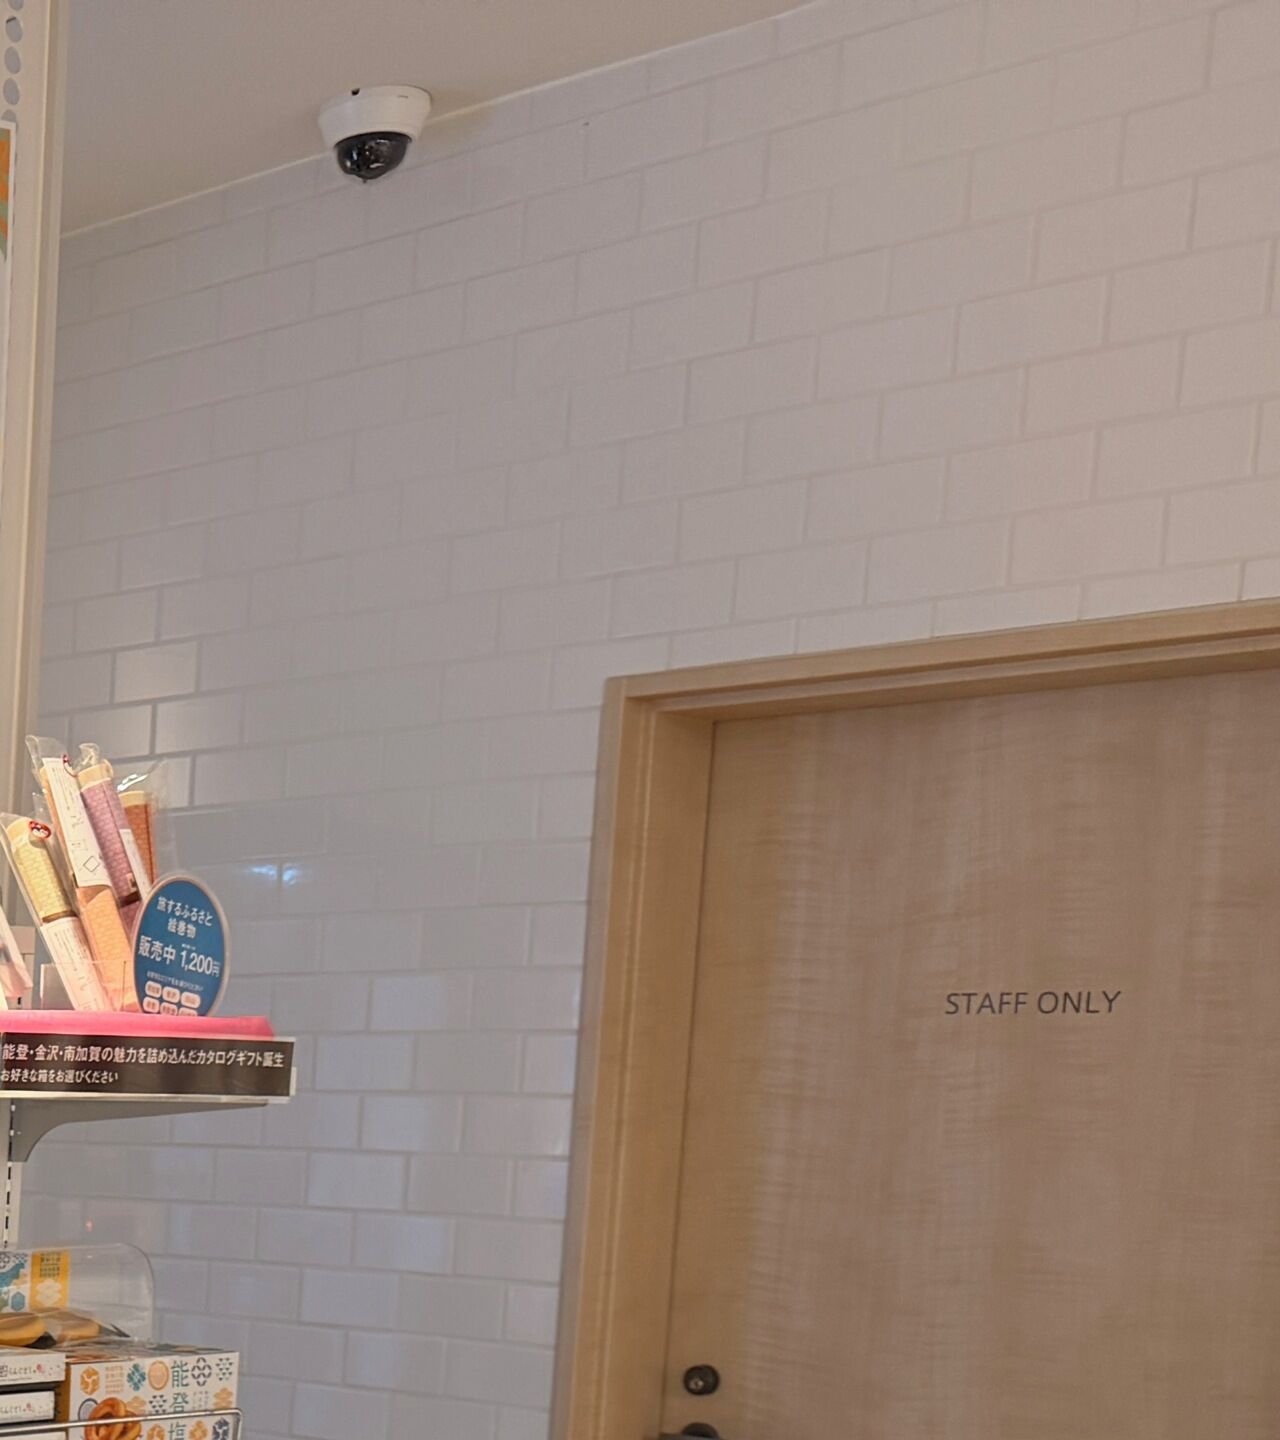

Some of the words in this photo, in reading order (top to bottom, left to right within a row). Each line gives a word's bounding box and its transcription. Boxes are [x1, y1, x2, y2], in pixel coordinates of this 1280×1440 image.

[138, 935, 176, 965] 販売中
[945, 992, 1028, 1015] STAFF
[1038, 991, 1121, 1014] ONLY
[0, 1068, 119, 1085] お好きな箱をお選びください
